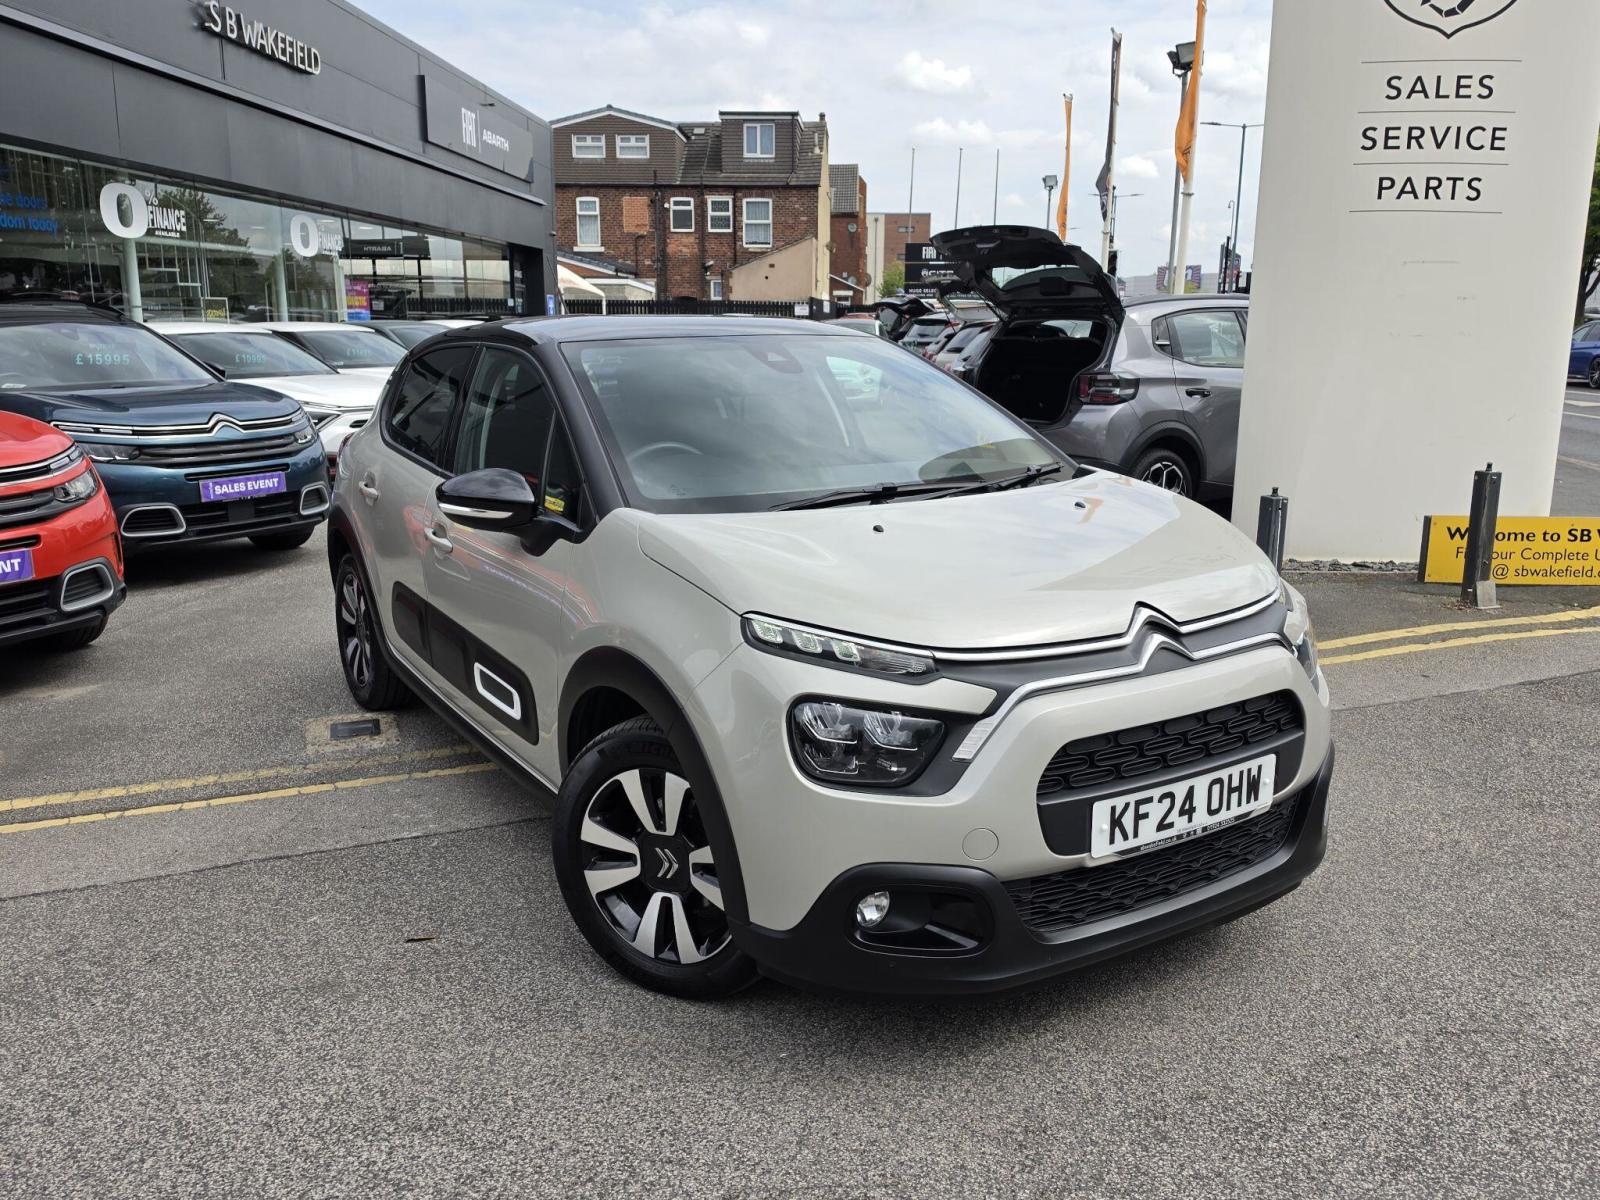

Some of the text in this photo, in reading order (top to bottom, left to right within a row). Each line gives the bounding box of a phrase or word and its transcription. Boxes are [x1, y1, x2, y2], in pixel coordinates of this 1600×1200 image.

[204, 0, 321, 75] S B WAKEFIELD
[1385, 74, 1495, 100] SALES
[461, 107, 477, 148] FIAT
[482, 128, 510, 152] ABARTH
[1360, 126, 1508, 151] SERVICE
[1377, 176, 1483, 201] PARTS
[147, 205, 187, 232] FINANCE
[214, 481, 246, 495] SALES
[247, 478, 279, 491] EVENT
[1447, 526, 1536, 542] Wome
[1542, 530, 1561, 542] to
[1567, 528, 1592, 542] SB
[1521, 547, 1589, 564] Complete
[1514, 564, 1600, 578] sbwakefield.
[1109, 764, 1262, 845] KF24 OHW
